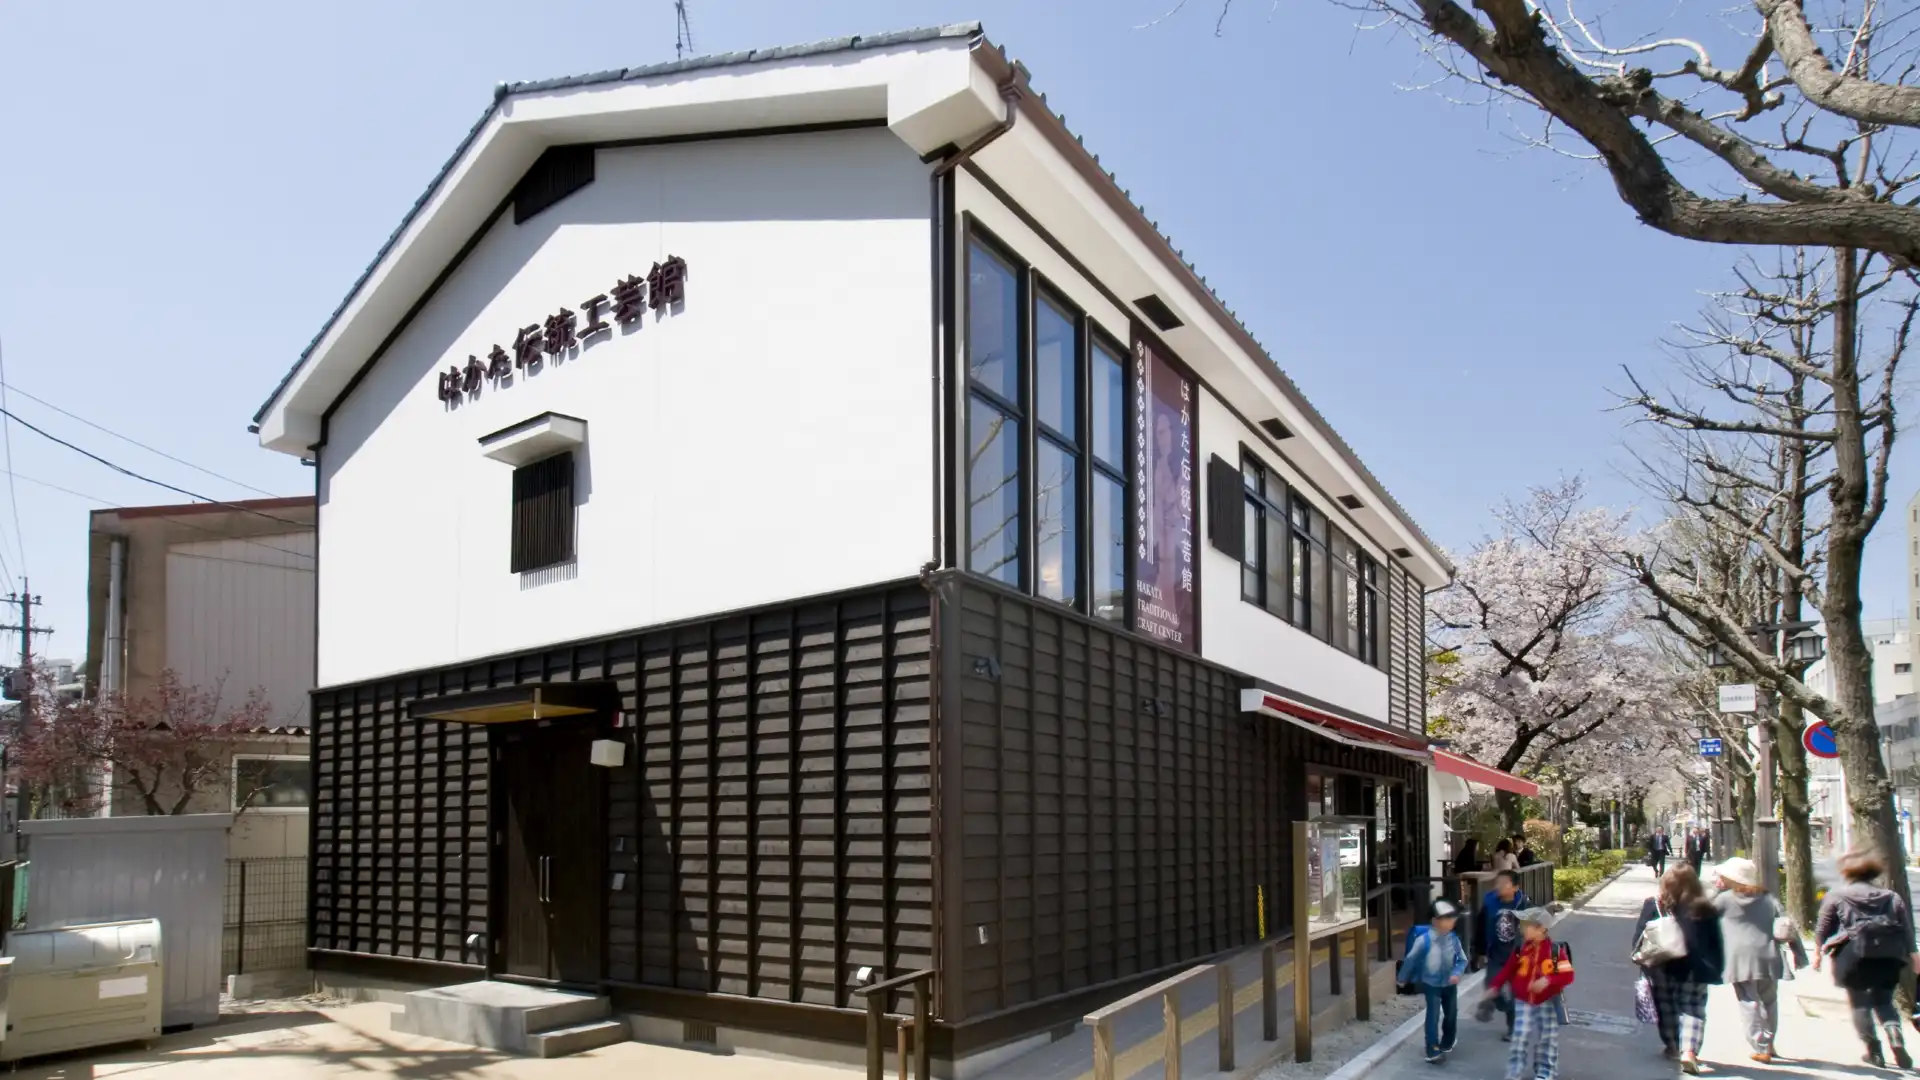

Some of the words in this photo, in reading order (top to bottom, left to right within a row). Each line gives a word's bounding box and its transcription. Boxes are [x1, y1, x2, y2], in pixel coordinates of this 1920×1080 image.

[438, 254, 686, 402] はかた伝統工芸館
[1136, 579, 1163, 601] HAKATA
[1137, 598, 1179, 627] TRADITIONAL
[1137, 617, 1157, 634] CRAFT
[1158, 624, 1183, 643] CENTER
